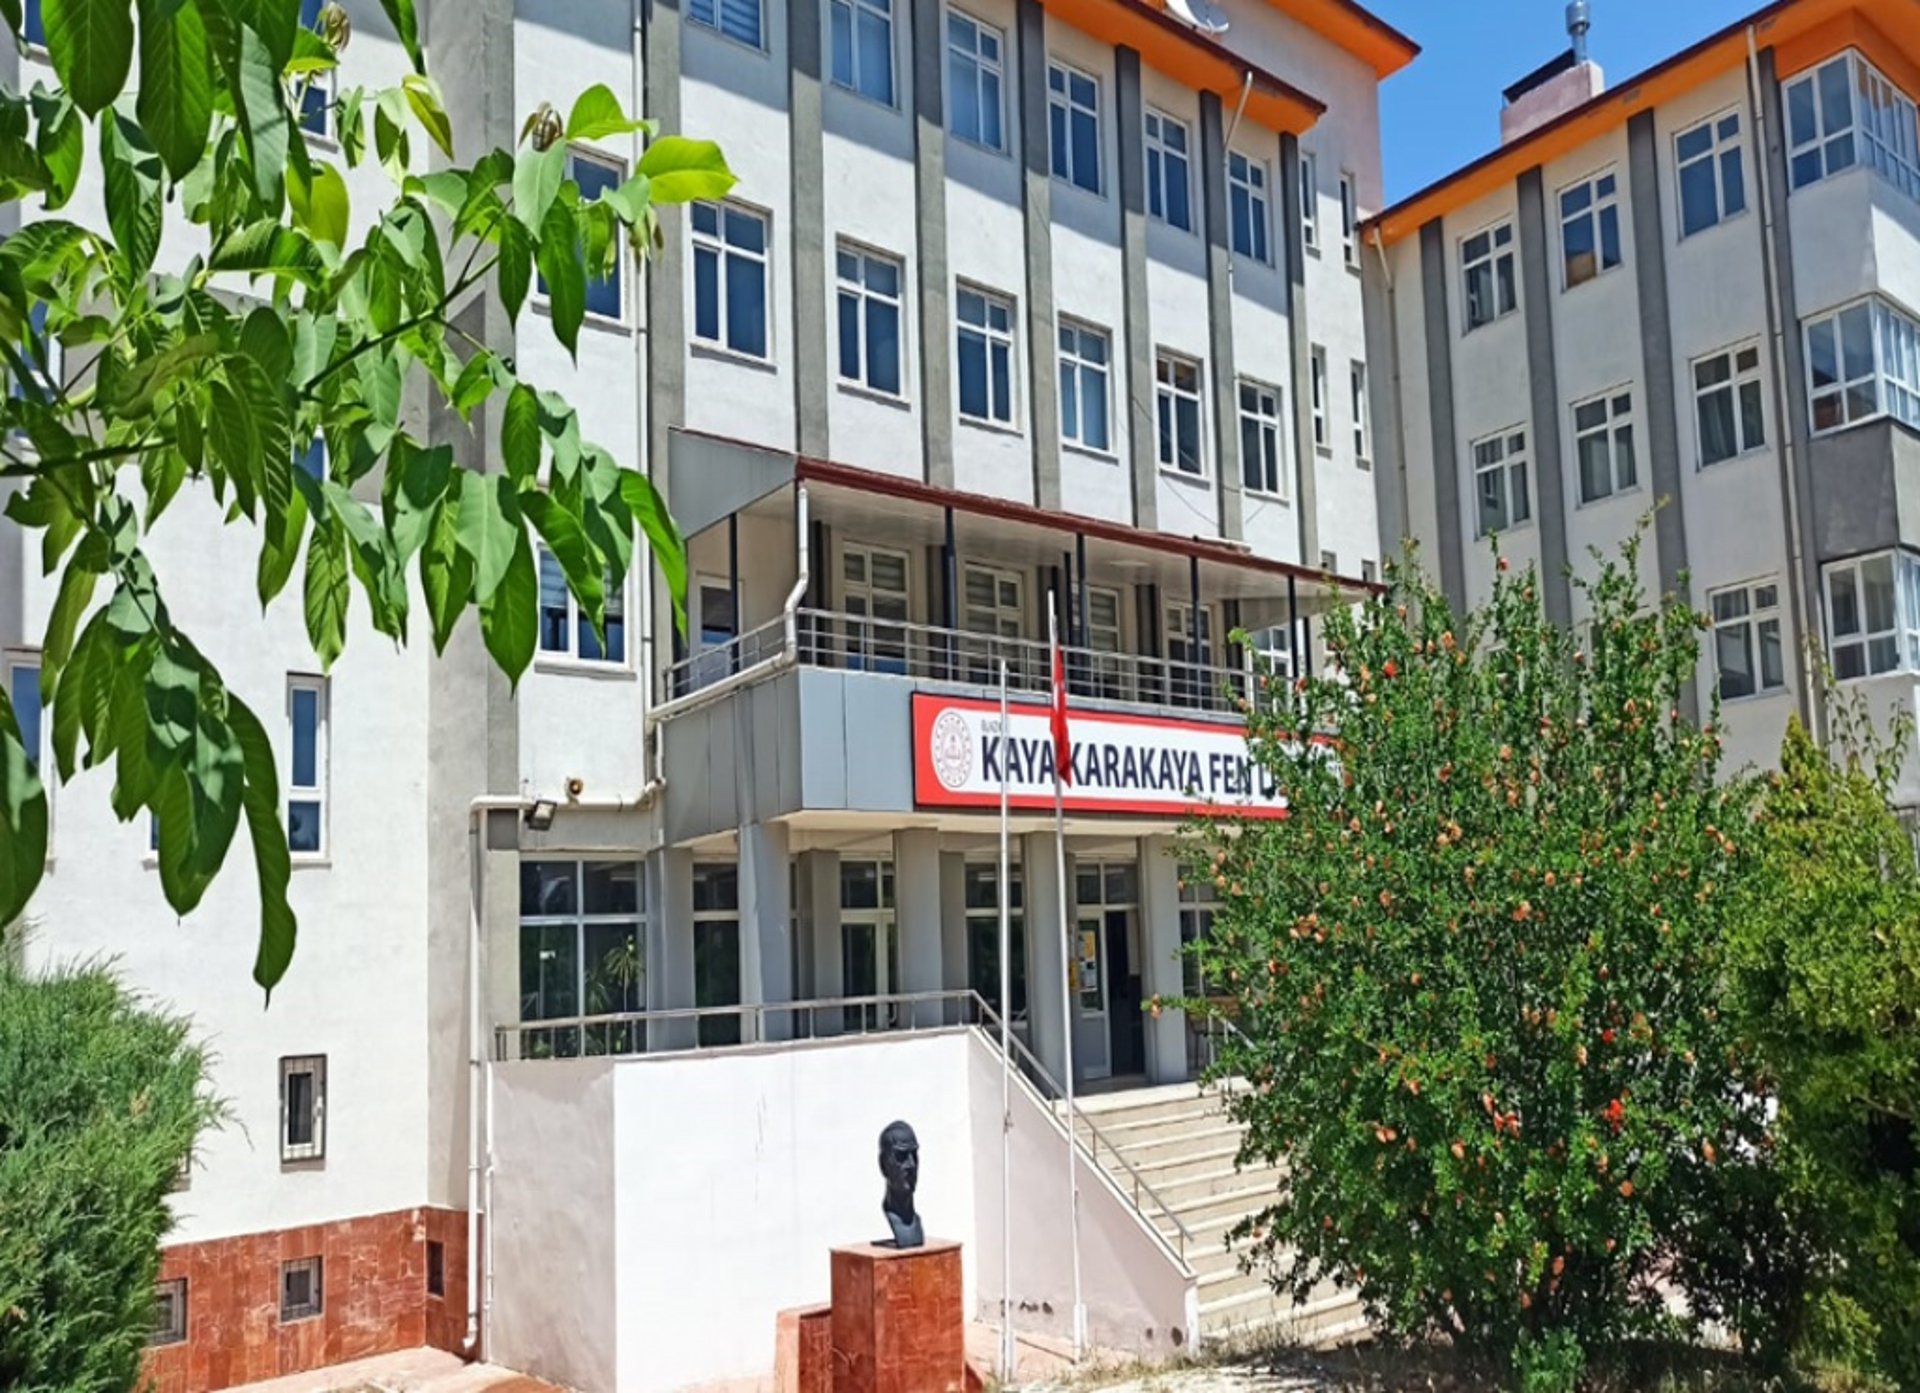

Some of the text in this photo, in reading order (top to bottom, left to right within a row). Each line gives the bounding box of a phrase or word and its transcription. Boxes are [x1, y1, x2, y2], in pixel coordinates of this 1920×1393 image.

[982, 735, 1056, 784] KAYA
[1069, 742, 1204, 793] KARAKAYA
[1208, 753, 1252, 795] FEN
